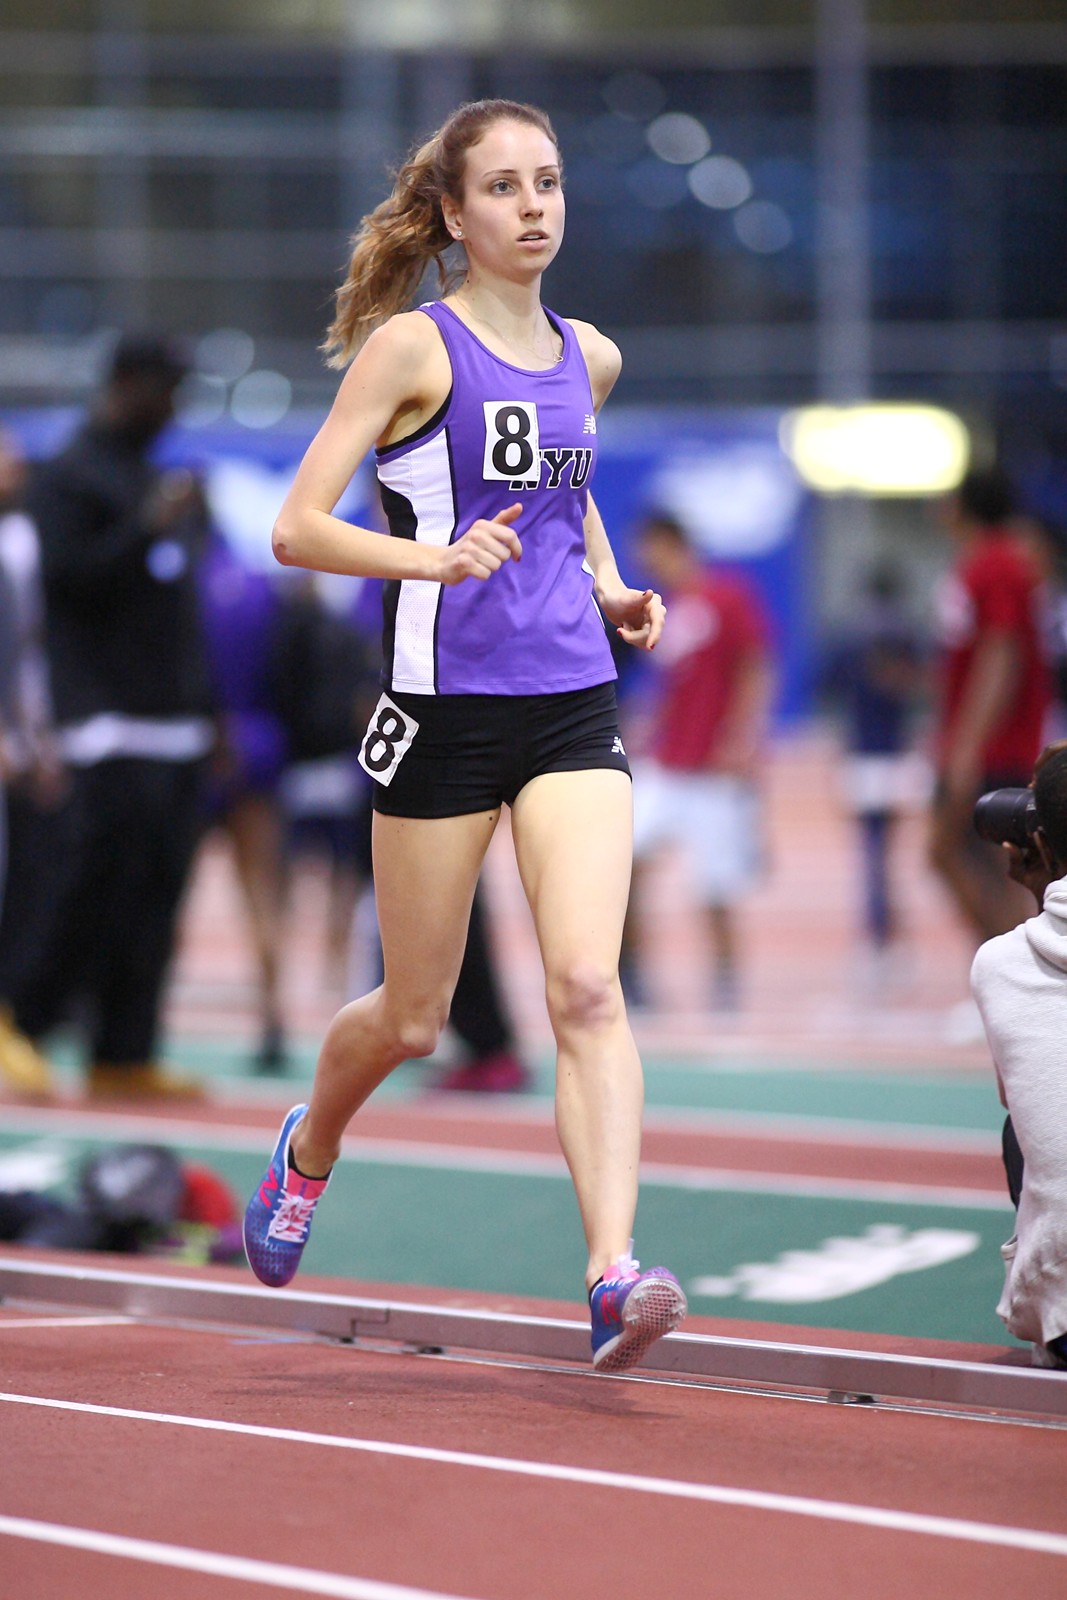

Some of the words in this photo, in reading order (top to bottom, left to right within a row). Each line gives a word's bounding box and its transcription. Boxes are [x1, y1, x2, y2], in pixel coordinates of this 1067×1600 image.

[492, 406, 533, 475] 8
[509, 448, 592, 490] YU
[365, 707, 406, 772] 8
